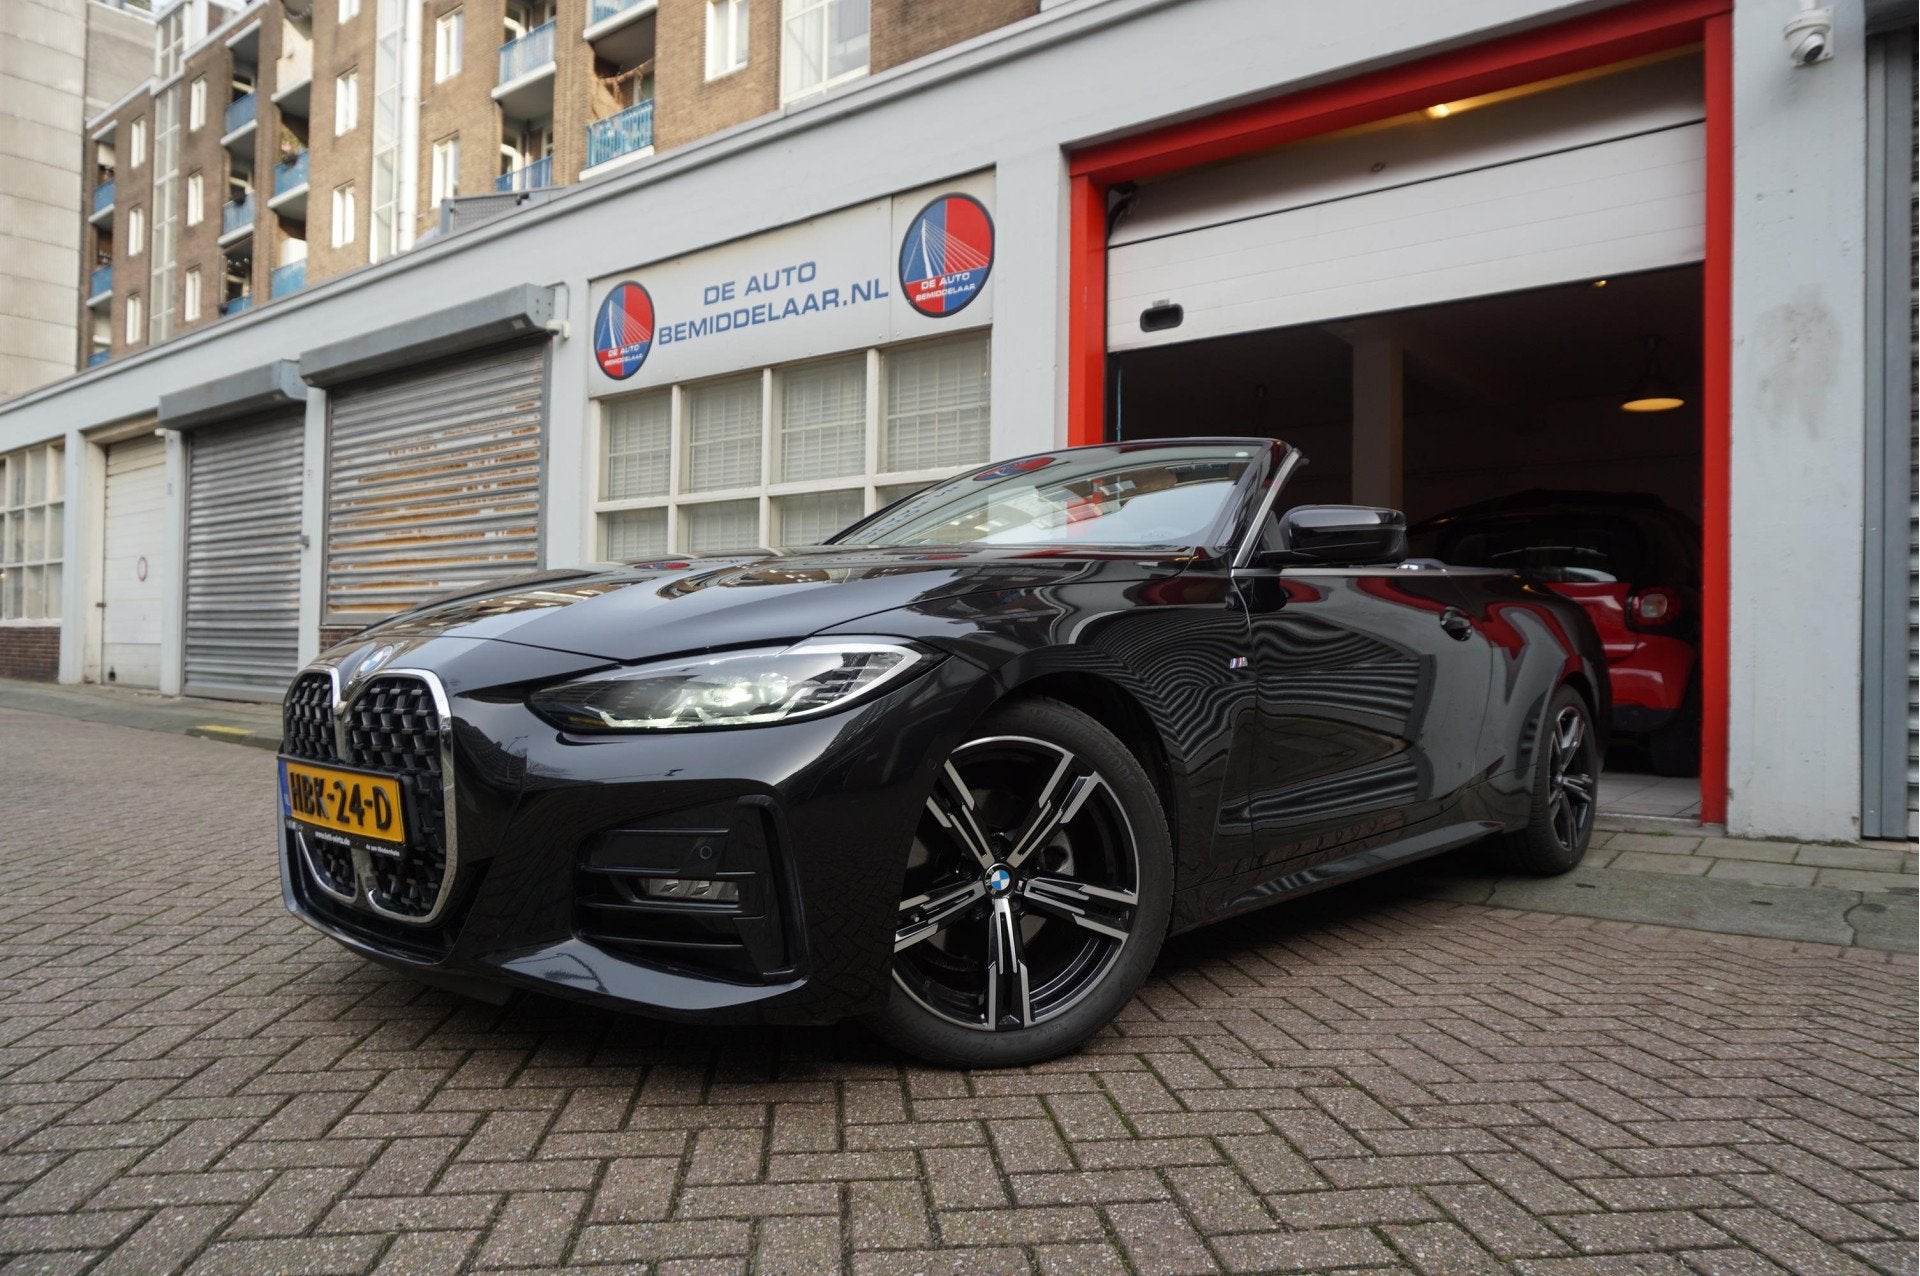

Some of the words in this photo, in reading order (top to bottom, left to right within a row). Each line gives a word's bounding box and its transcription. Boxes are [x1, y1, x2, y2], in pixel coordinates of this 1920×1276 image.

[704, 281, 735, 305] DE
[744, 261, 816, 296] AUTO
[915, 283, 976, 301] BEMIDDELAAR
[921, 279, 936, 290] DE
[939, 272, 970, 286] AUTO
[658, 278, 889, 345] BEMIDDELAAR.NL
[608, 349, 618, 357] DE
[620, 344, 639, 354] AUTO
[289, 771, 393, 830] HBK-24-D
